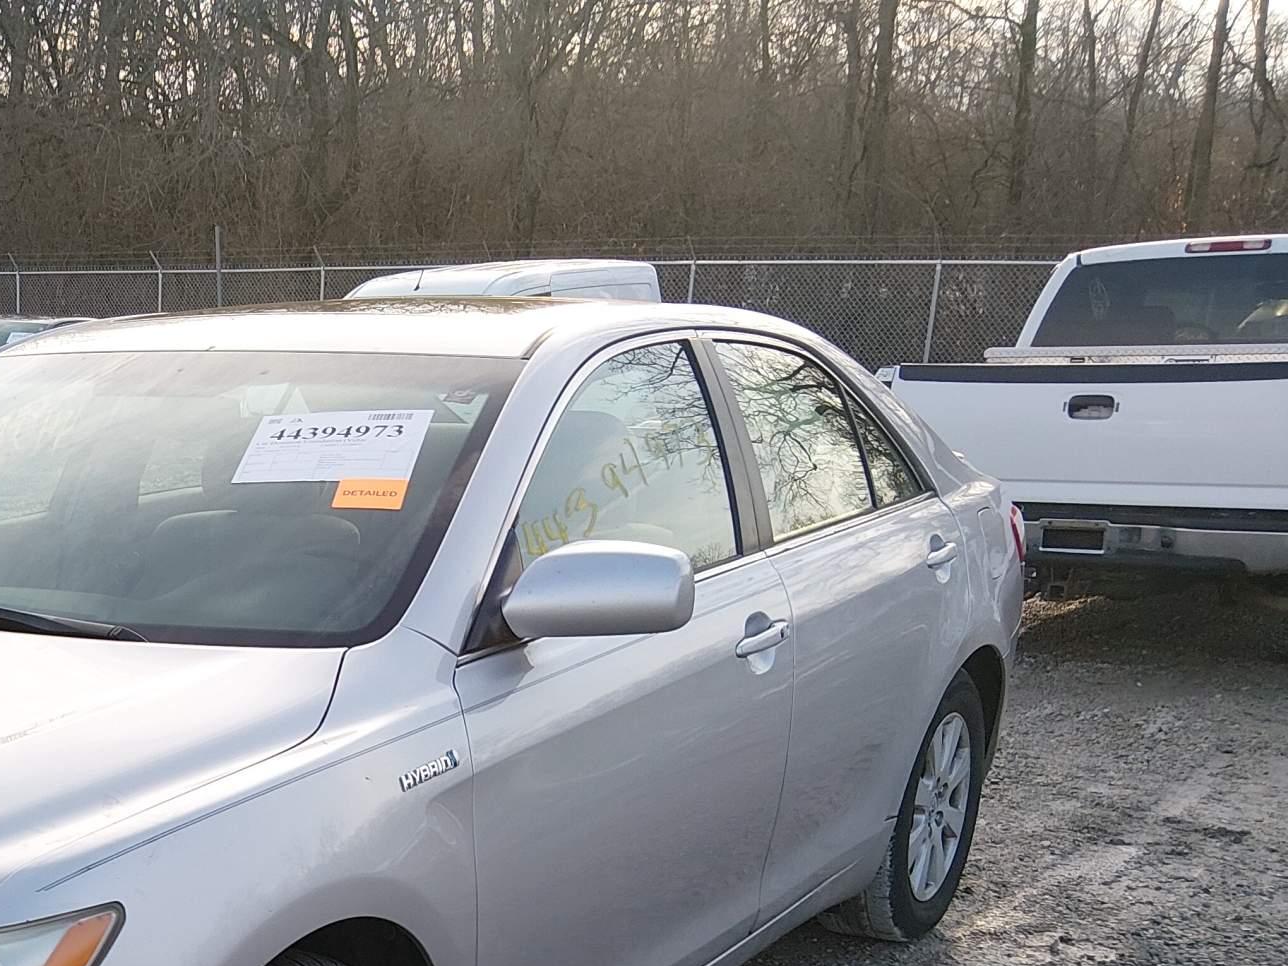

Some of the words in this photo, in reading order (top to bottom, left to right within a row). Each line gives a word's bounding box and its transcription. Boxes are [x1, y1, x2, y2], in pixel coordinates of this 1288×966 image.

[269, 424, 405, 441] 44394973
[342, 488, 398, 498] DETAILED
[399, 755, 455, 793] HYBRID
